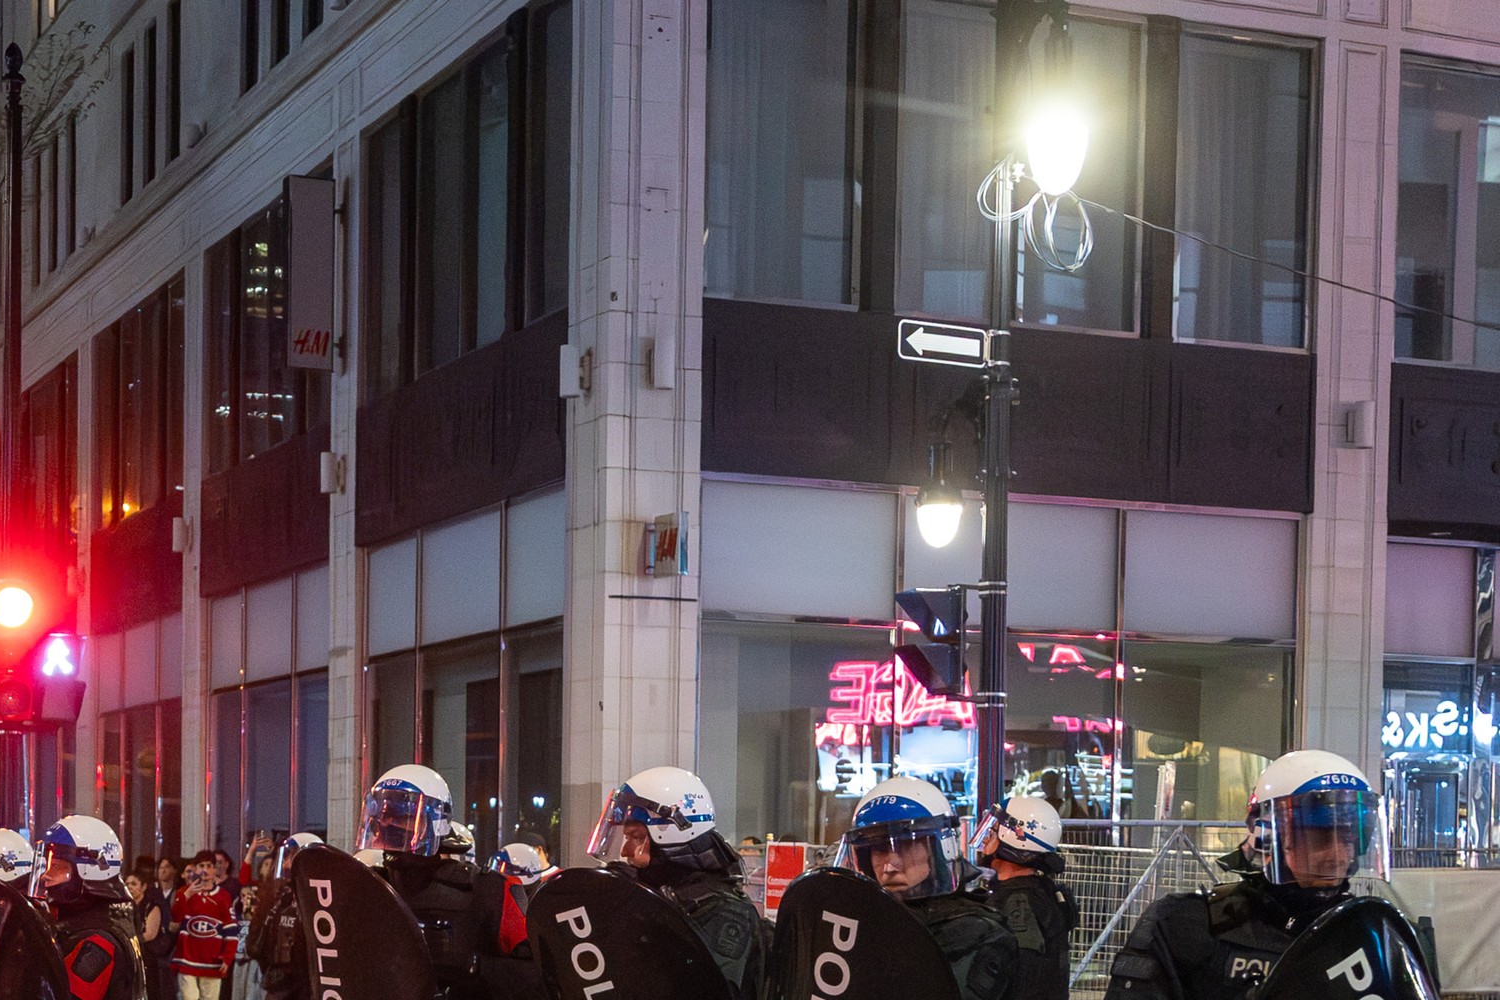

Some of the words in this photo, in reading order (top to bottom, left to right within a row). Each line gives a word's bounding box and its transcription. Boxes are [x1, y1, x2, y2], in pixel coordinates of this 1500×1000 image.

[293, 329, 330, 357] H&M
[1322, 774, 1358, 786] 7604
[870, 796, 897, 808] 7779
